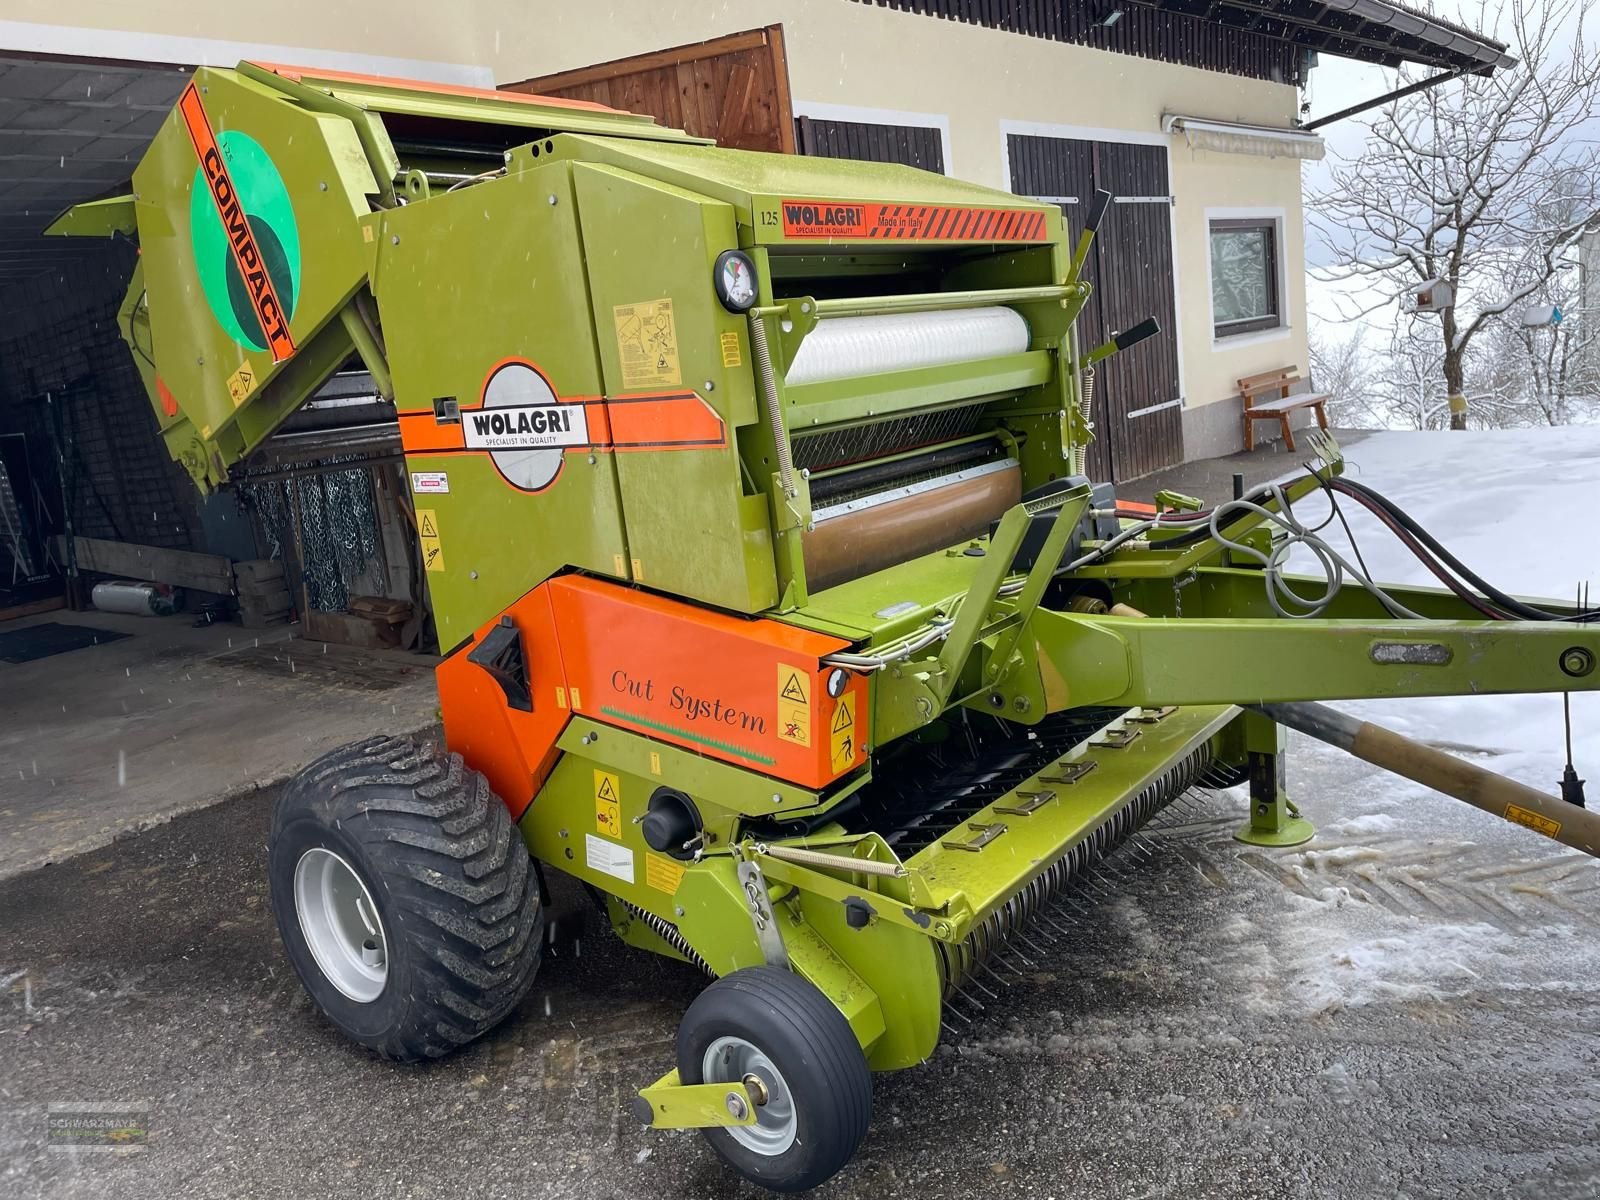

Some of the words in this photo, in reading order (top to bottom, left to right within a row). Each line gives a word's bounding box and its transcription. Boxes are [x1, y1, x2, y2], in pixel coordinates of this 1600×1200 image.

[222, 141, 234, 162] 125
[760, 211, 778, 226] 125
[785, 205, 861, 227] WOLAGRI
[878, 216, 898, 227] Made
[908, 217, 923, 230] Italy
[795, 226, 823, 234] SPECIALIST
[204, 147, 288, 342] COMPACT
[473, 410, 570, 436] WOLAGRI
[485, 438, 518, 446] SPECIALIST
[520, 437, 527, 445] IN
[529, 436, 557, 444] QUALITY
[612, 670, 654, 701] Cut
[670, 686, 767, 734] System
